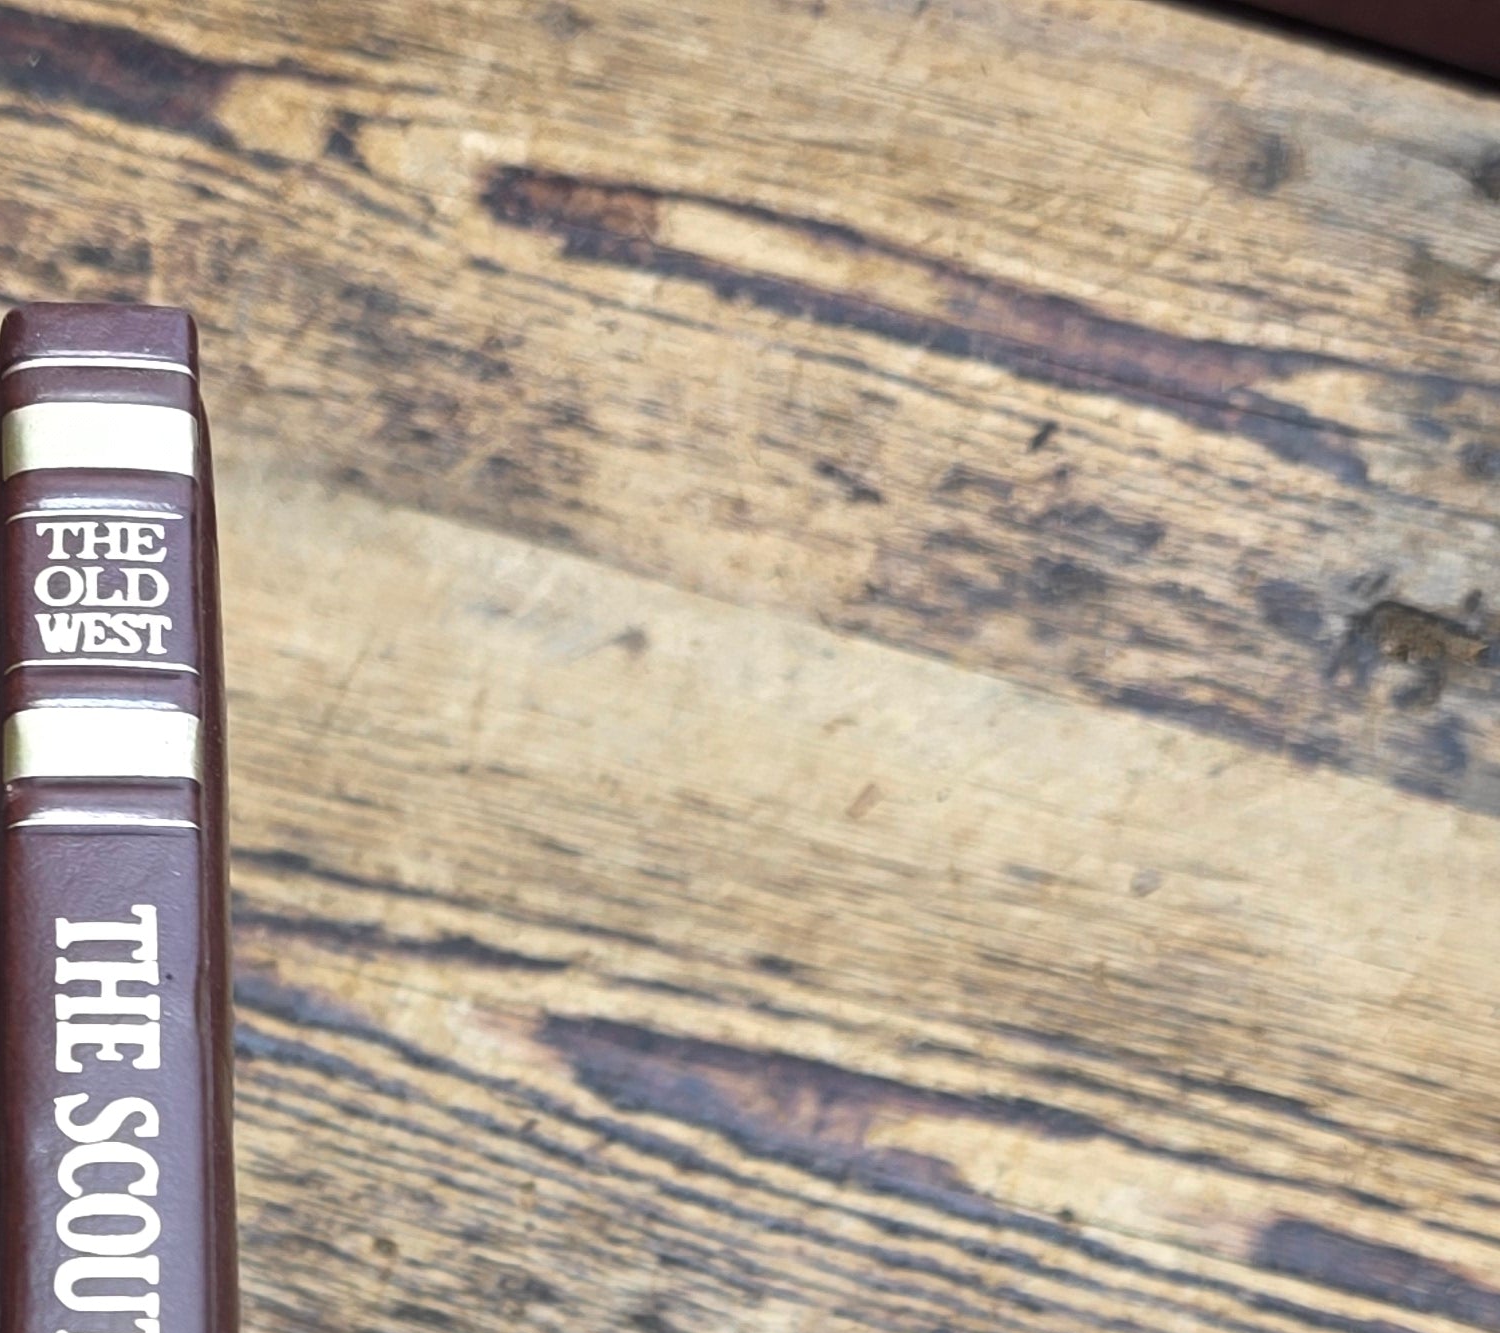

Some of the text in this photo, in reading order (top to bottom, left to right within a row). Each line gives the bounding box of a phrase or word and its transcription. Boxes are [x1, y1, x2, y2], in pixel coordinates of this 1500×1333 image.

[35, 521, 167, 563] THE
[33, 565, 170, 608] OLD
[33, 611, 173, 655] WEST
[54, 903, 161, 1074] THE
